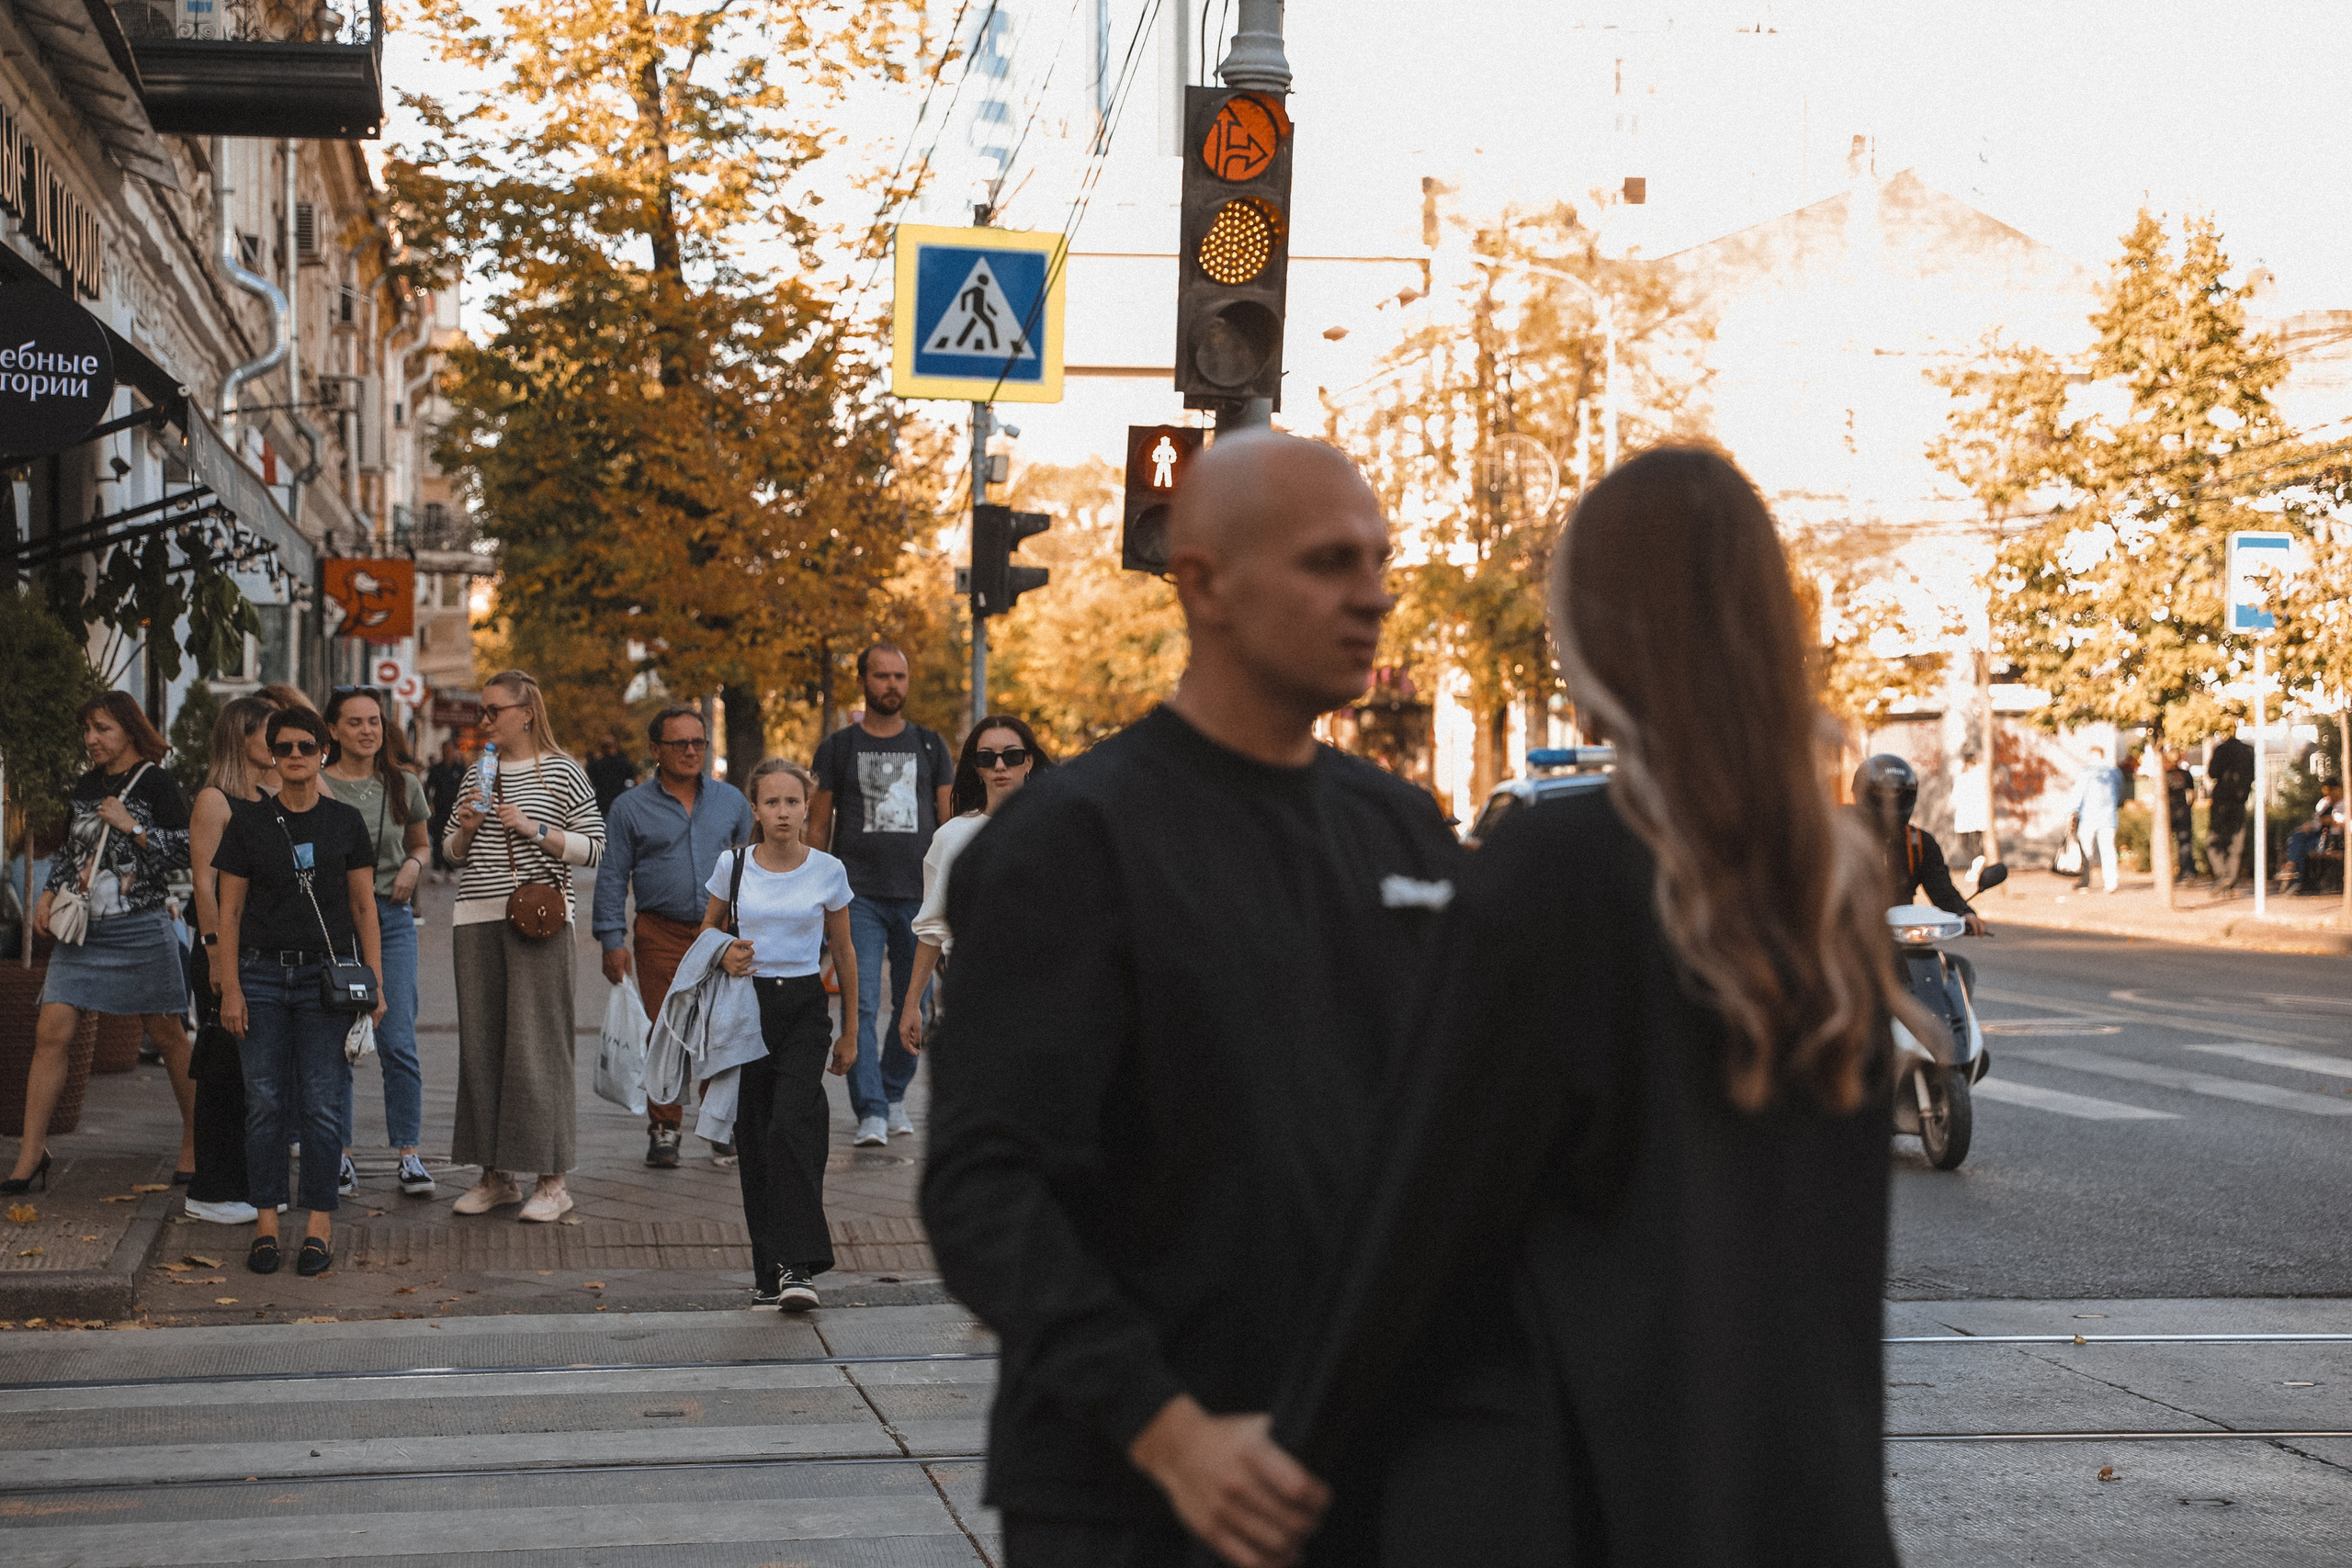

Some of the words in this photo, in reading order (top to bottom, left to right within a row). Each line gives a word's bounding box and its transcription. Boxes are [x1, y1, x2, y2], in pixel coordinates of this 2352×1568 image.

[0, 104, 27, 220] ые
[0, 340, 98, 376] ебные
[0, 371, 89, 402] тории
